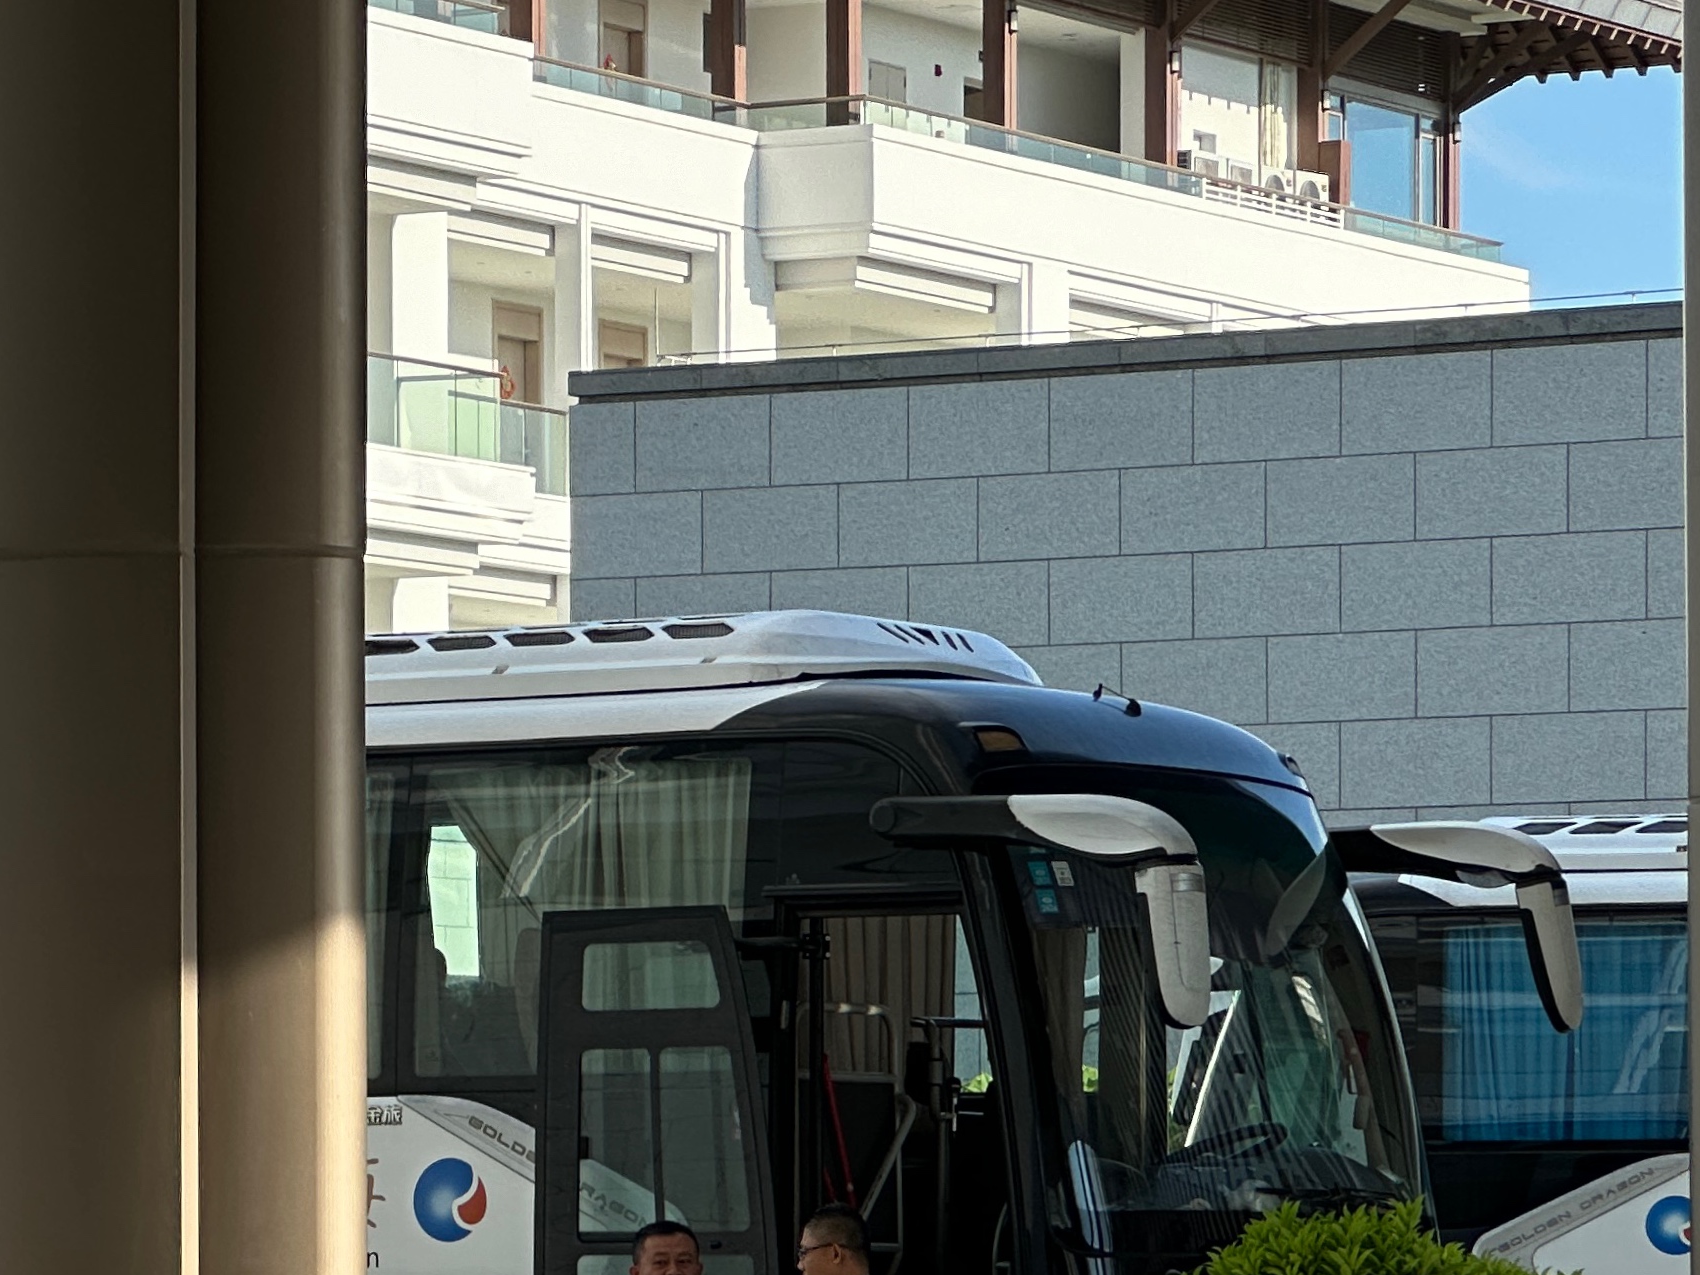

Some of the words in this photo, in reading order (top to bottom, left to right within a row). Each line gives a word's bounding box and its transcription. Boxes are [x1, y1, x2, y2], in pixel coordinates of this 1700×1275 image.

[468, 1115, 536, 1164] GOLDE
[1497, 1210, 1572, 1254] GOLDEN
[1579, 1167, 1655, 1211] DRAGON
